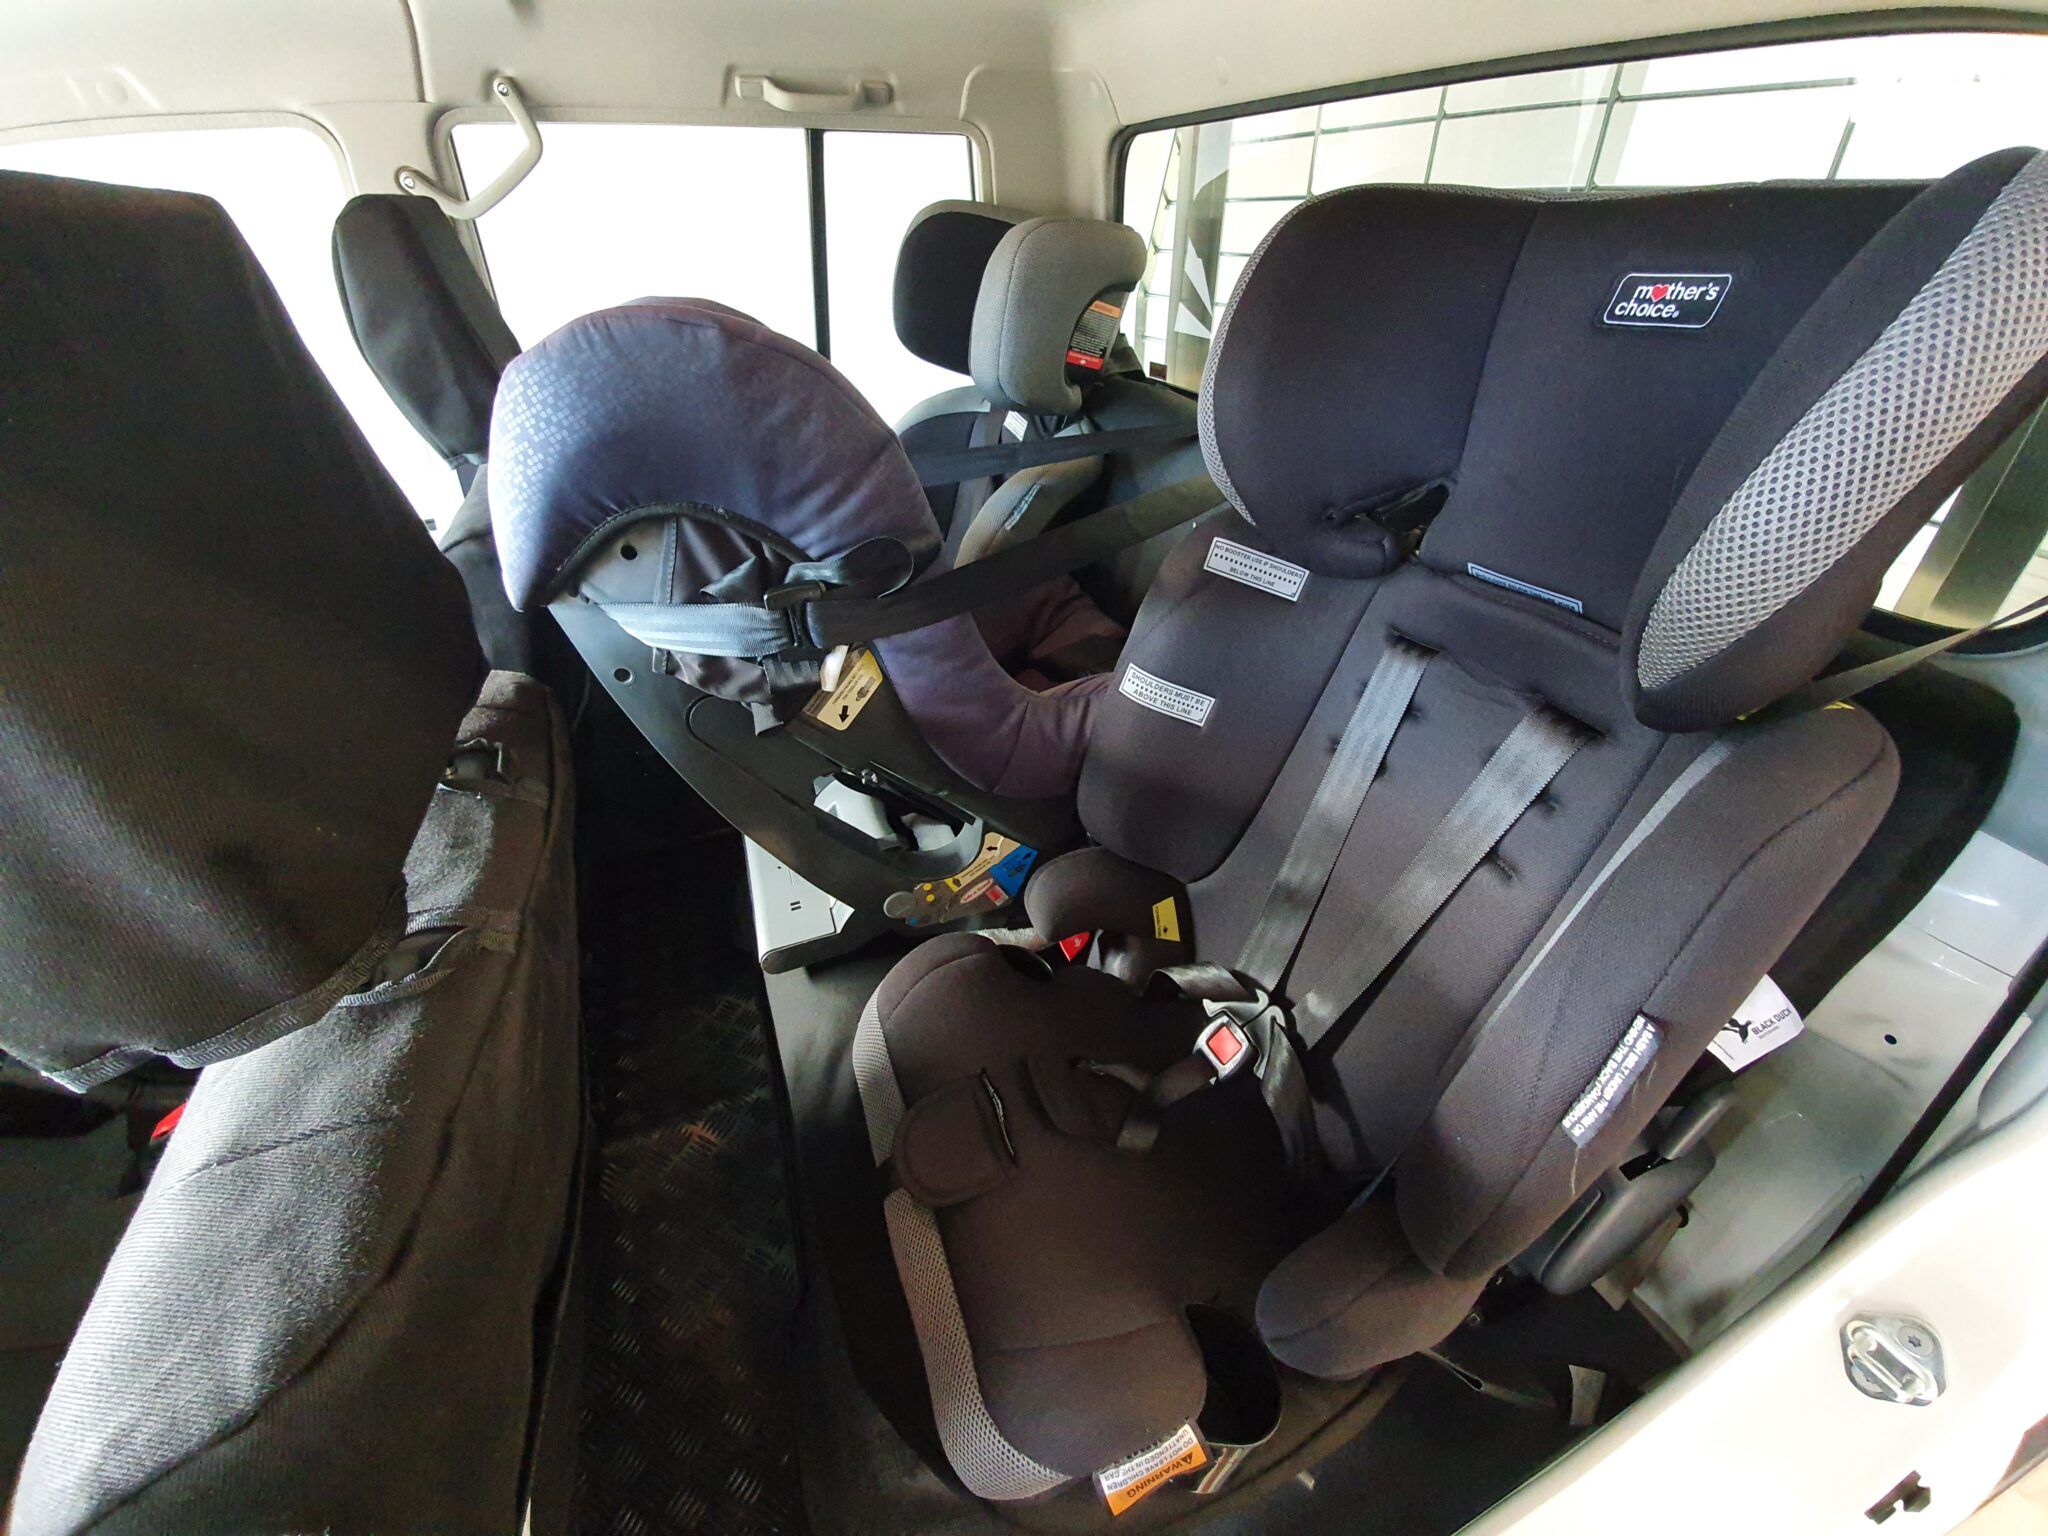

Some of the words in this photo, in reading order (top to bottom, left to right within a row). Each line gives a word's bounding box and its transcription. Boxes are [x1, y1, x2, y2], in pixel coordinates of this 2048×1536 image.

[1225, 547, 1251, 560] BOOSTER
[1252, 556, 1262, 564] USE
[1269, 563, 1302, 578] SHOULDERS
[1230, 567, 1249, 577] BELOW
[1251, 574, 1261, 582] THIS
[1263, 579, 1275, 587] LINE
[1132, 672, 1173, 695] SHOULDERS
[1175, 691, 1193, 702] MUST
[1133, 689, 1158, 704] ABOVE
[1160, 701, 1175, 710] THIS
[1177, 706, 1192, 716] LINE
[1751, 1018, 1776, 1035] BLACK
[1611, 1044, 1629, 1063] THE
[1620, 1050, 1639, 1076] BELT
[1597, 1058, 1618, 1085] BACK
[1602, 1072, 1626, 1101] UNDER
[1145, 1429, 1188, 1465] UNATTENDED
[1169, 1446, 1183, 1459] NOT
[1183, 1437, 1193, 1448] DO
[1135, 1460, 1144, 1469] IN
[1146, 1455, 1168, 1473] LEAVE
[1104, 1470, 1120, 1482] CAR
[1107, 1470, 1144, 1491] CHILDREN
[1126, 1461, 1183, 1498] WARNING
